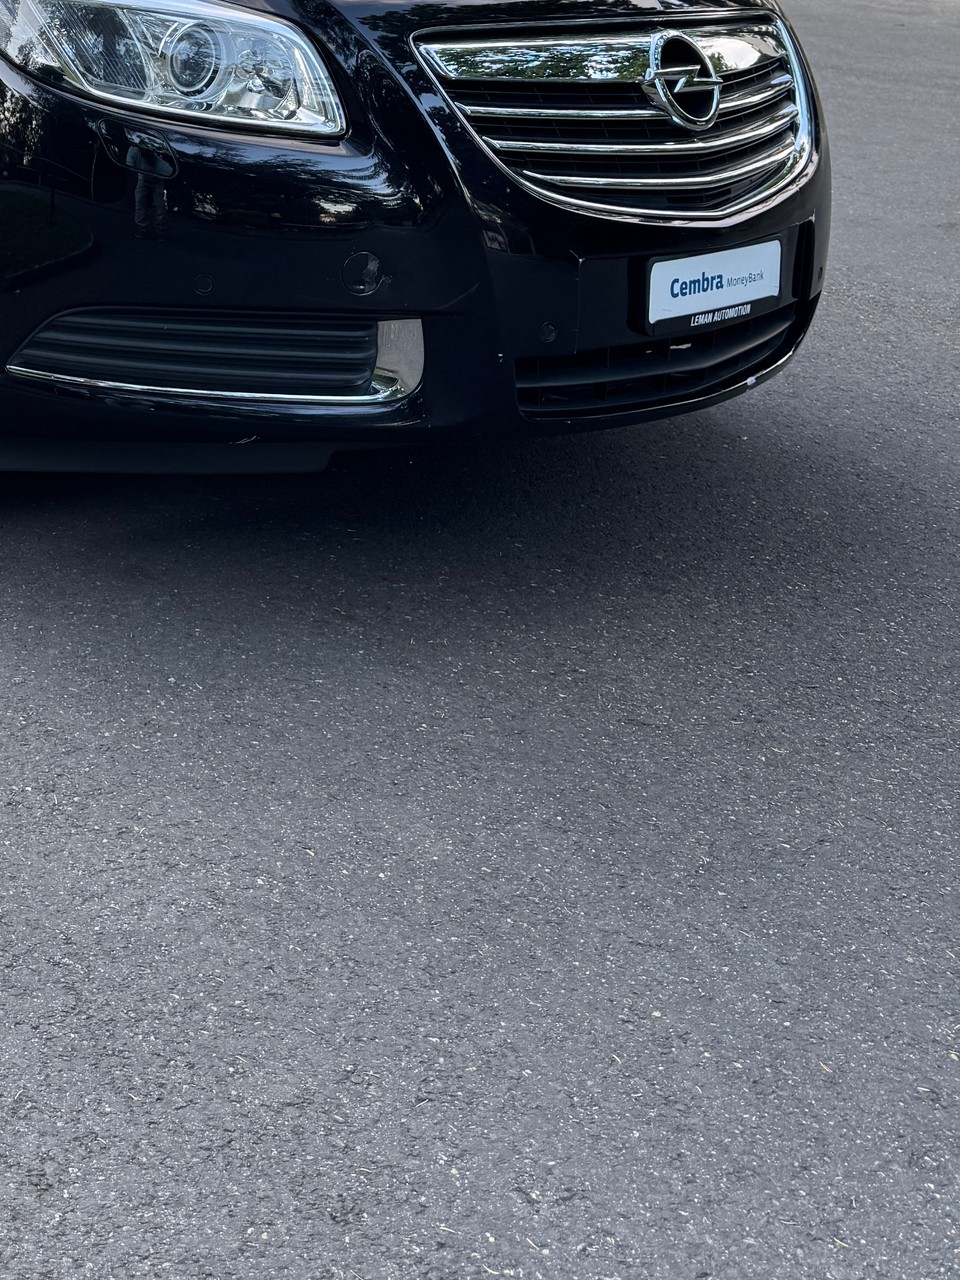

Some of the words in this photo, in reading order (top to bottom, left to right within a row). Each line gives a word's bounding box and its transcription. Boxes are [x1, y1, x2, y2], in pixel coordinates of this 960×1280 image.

[670, 271, 724, 298] Cembra
[726, 270, 764, 288] MoneyBank
[690, 312, 713, 326] LEMAN
[713, 303, 752, 321] AUTOMOTION
